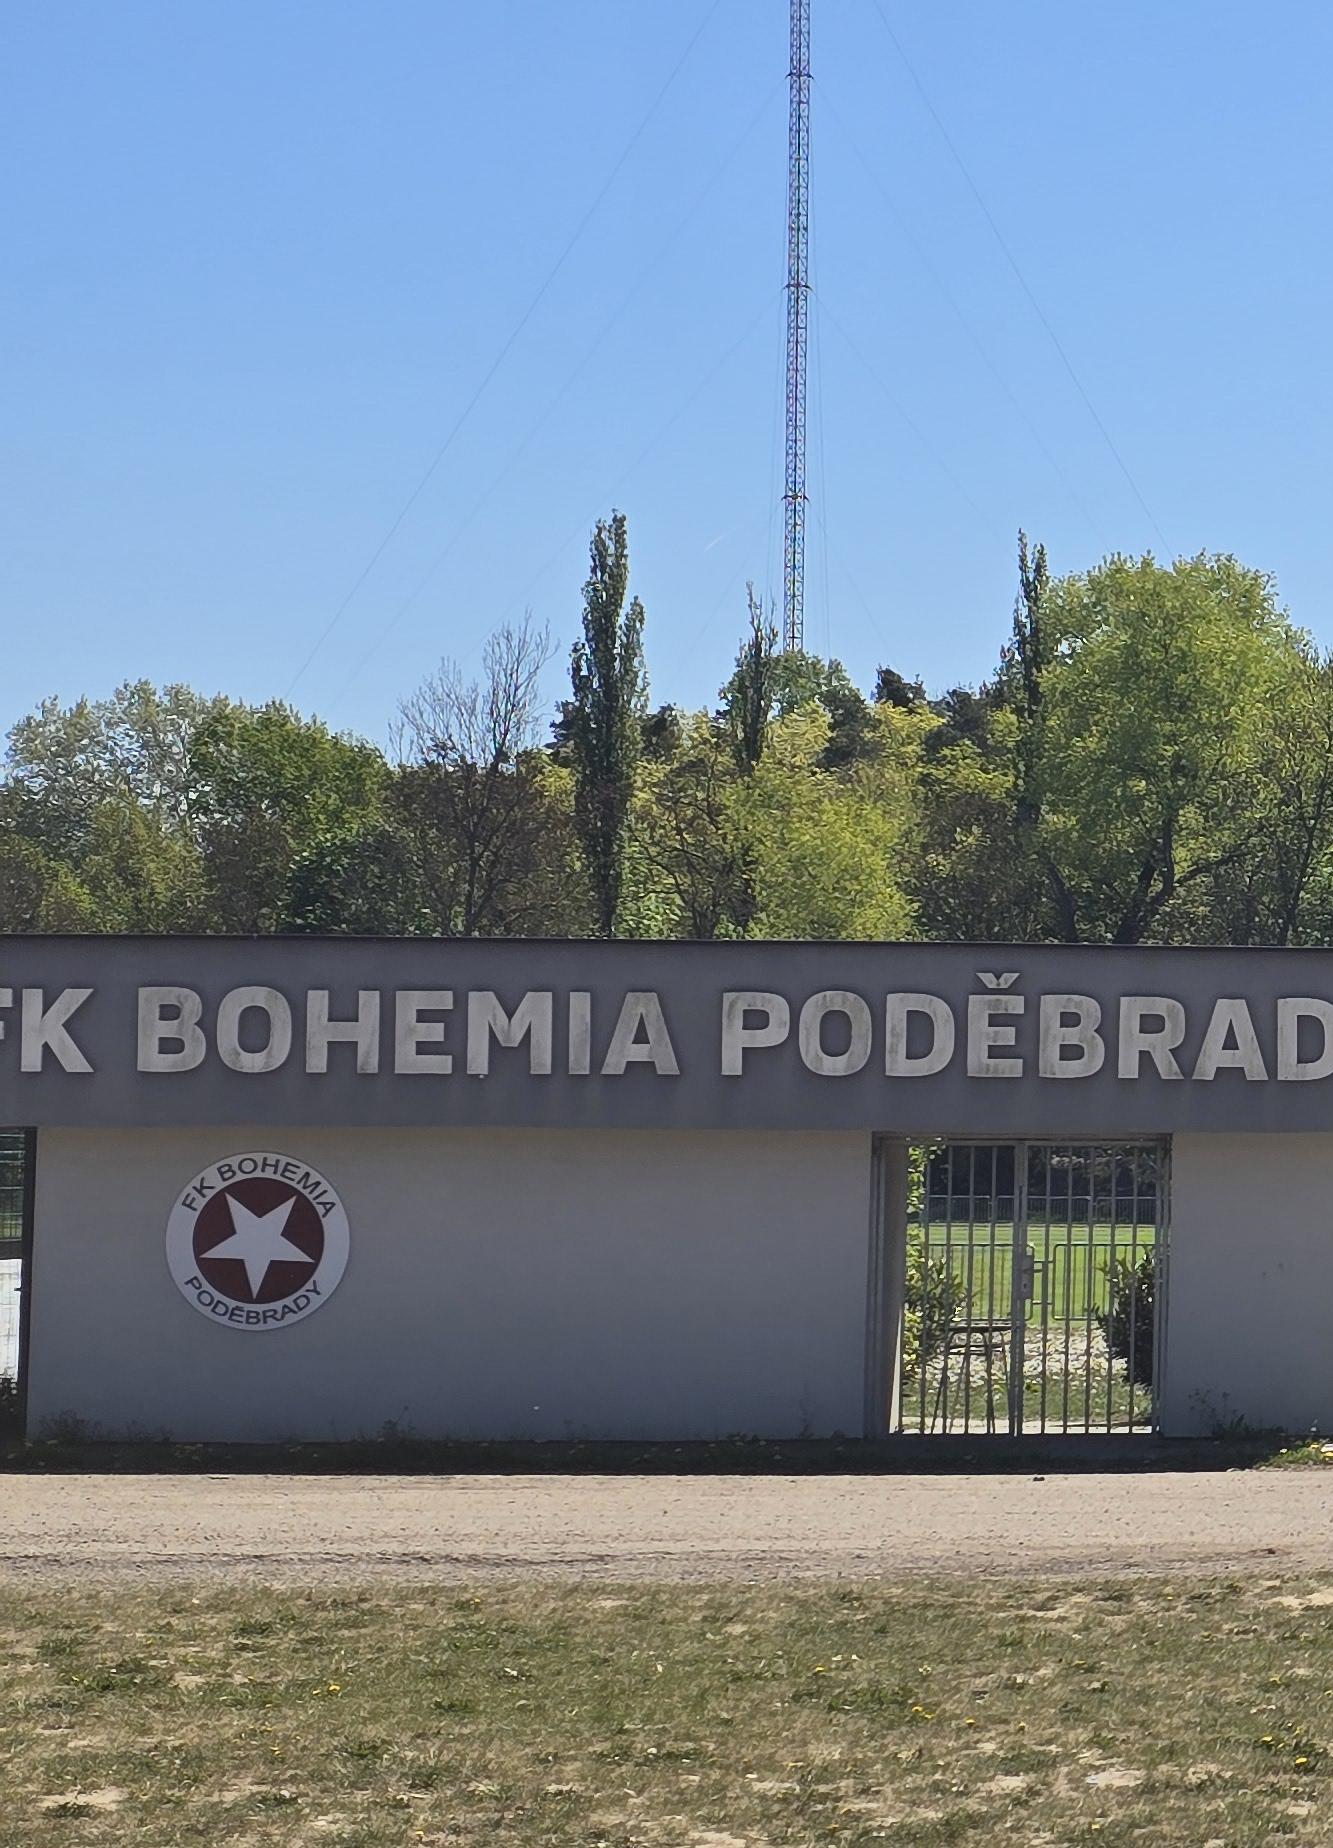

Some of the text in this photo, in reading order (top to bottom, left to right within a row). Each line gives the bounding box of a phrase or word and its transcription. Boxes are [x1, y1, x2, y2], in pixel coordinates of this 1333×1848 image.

[0, 988, 94, 1072] K
[136, 985, 680, 1076] BOHEMIA
[182, 1157, 337, 1218] FK BOHEMIA
[184, 1276, 321, 1325] PODĚBRADY
